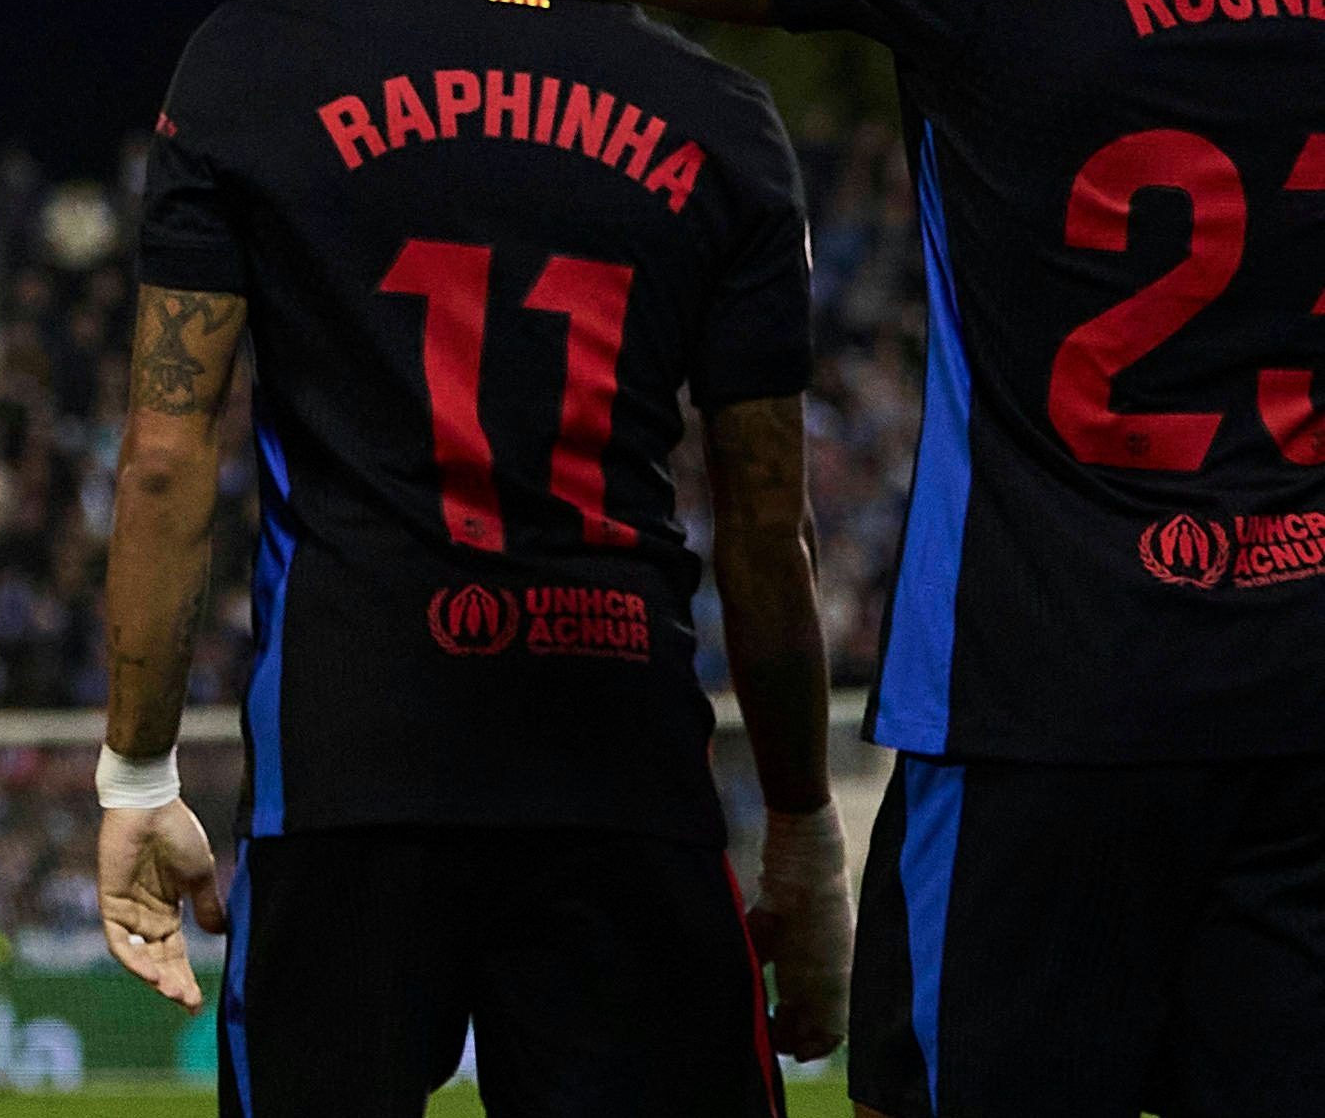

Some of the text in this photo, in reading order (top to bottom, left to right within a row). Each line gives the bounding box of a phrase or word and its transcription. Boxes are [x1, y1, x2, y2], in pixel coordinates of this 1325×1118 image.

[317, 68, 705, 214] RAPHINHA
[378, 238, 637, 552] 11
[525, 586, 648, 623] UNHCR
[526, 617, 649, 649] ACNUR
